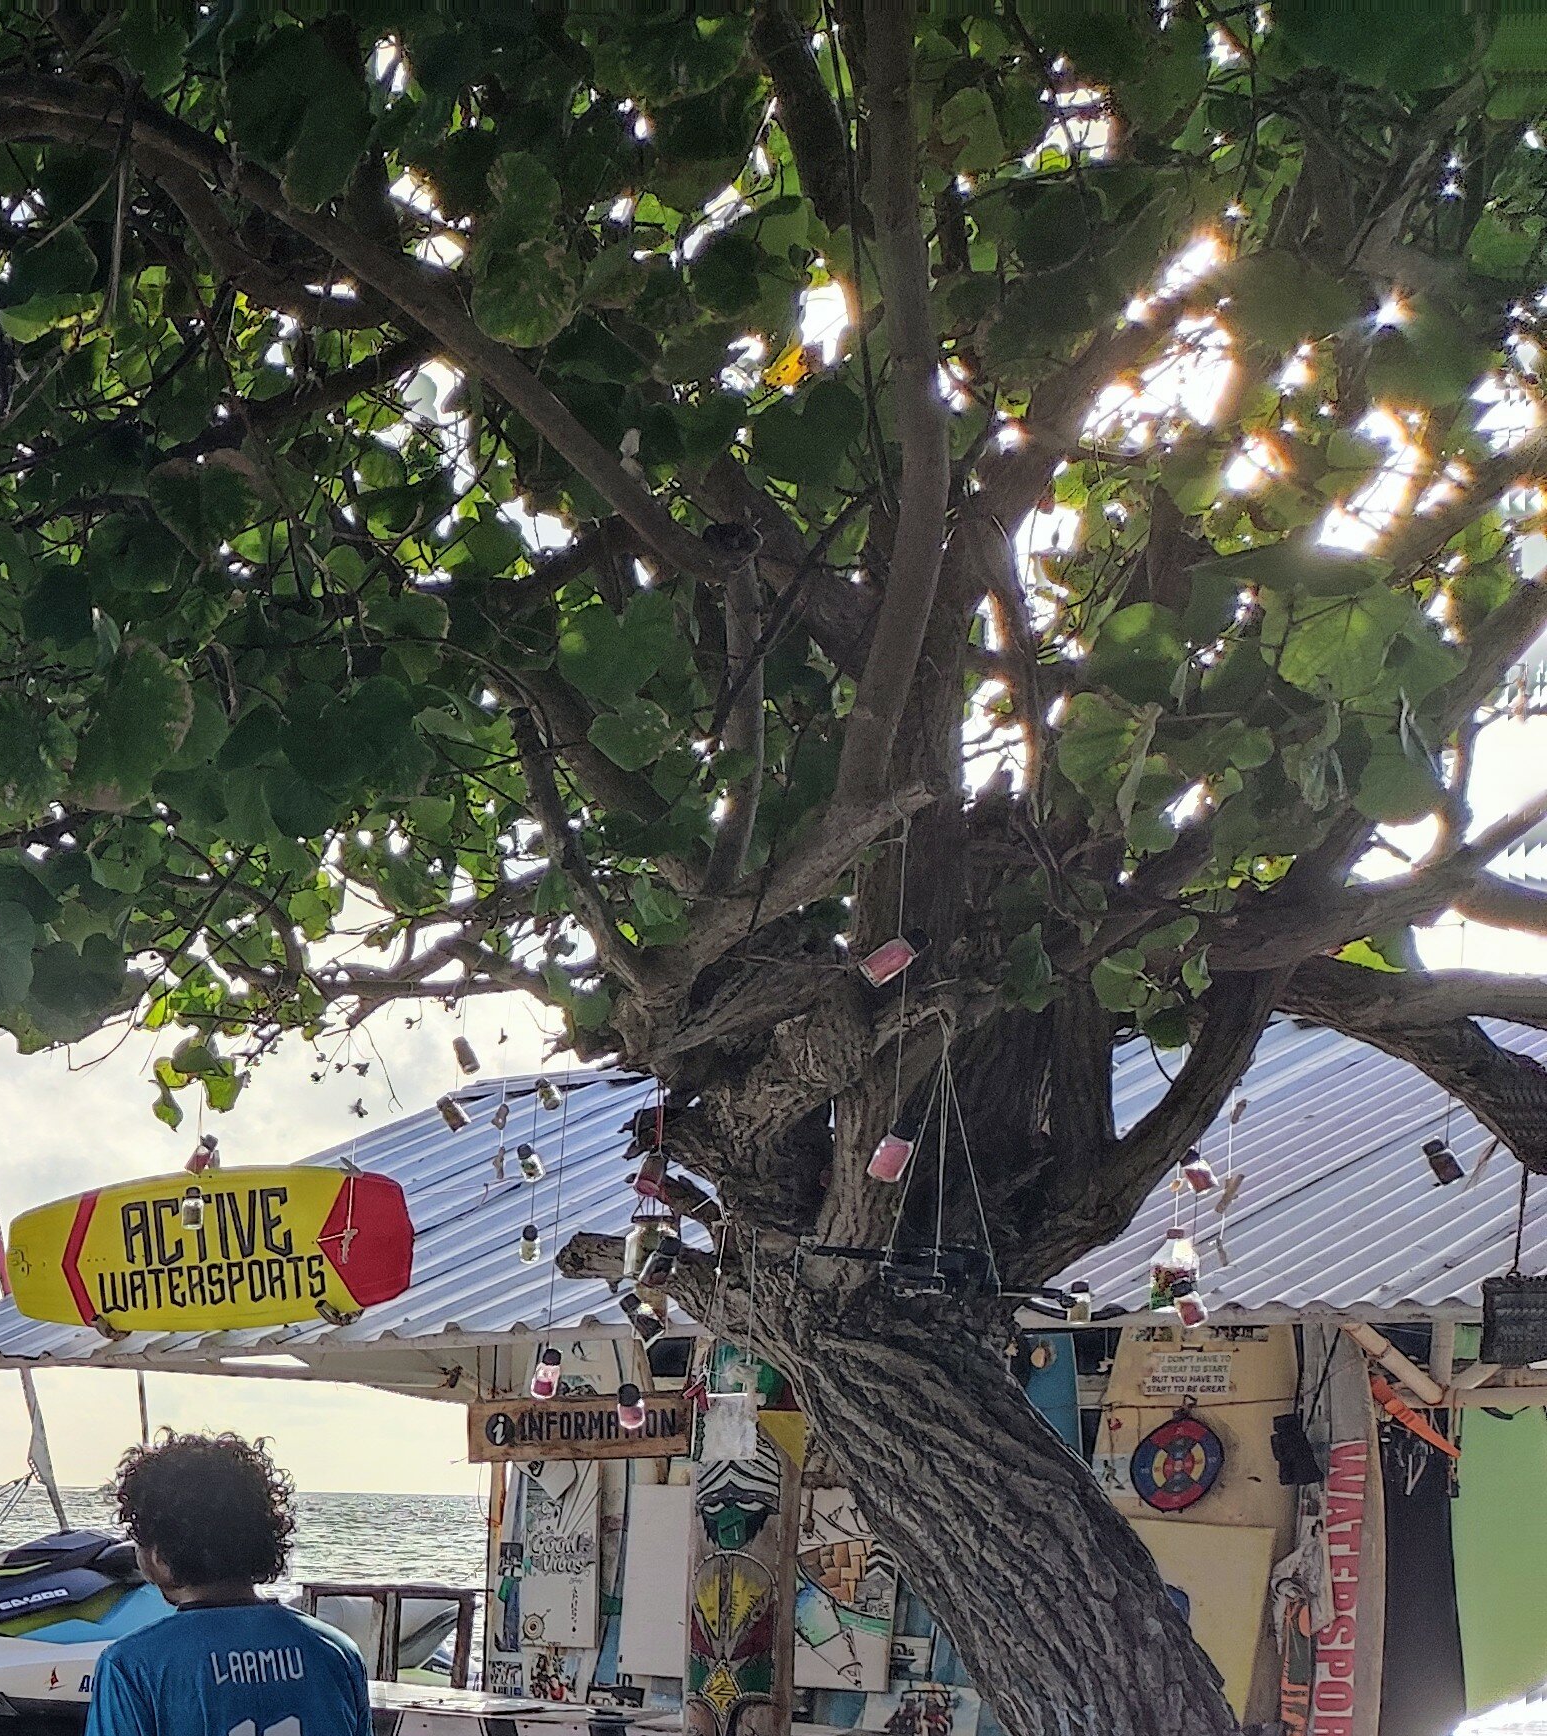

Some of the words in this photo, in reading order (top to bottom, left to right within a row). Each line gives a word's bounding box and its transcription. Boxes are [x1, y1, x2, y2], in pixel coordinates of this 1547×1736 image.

[120, 1186, 293, 1268] ACTIVE
[97, 1254, 327, 1314] WATERSPORTS
[1196, 1354, 1220, 1363] HAVE
[1221, 1354, 1232, 1363] TO
[1190, 1365, 1202, 1373] TO
[1151, 1375, 1168, 1383] BUT
[1171, 1374, 1187, 1383] YOU
[1189, 1374, 1211, 1383] HAVE
[1213, 1374, 1225, 1383] TO
[1146, 1385, 1171, 1393] START
[1173, 1385, 1185, 1393] TO
[1187, 1384, 1198, 1393] BE
[531, 1530, 582, 1554] Good
